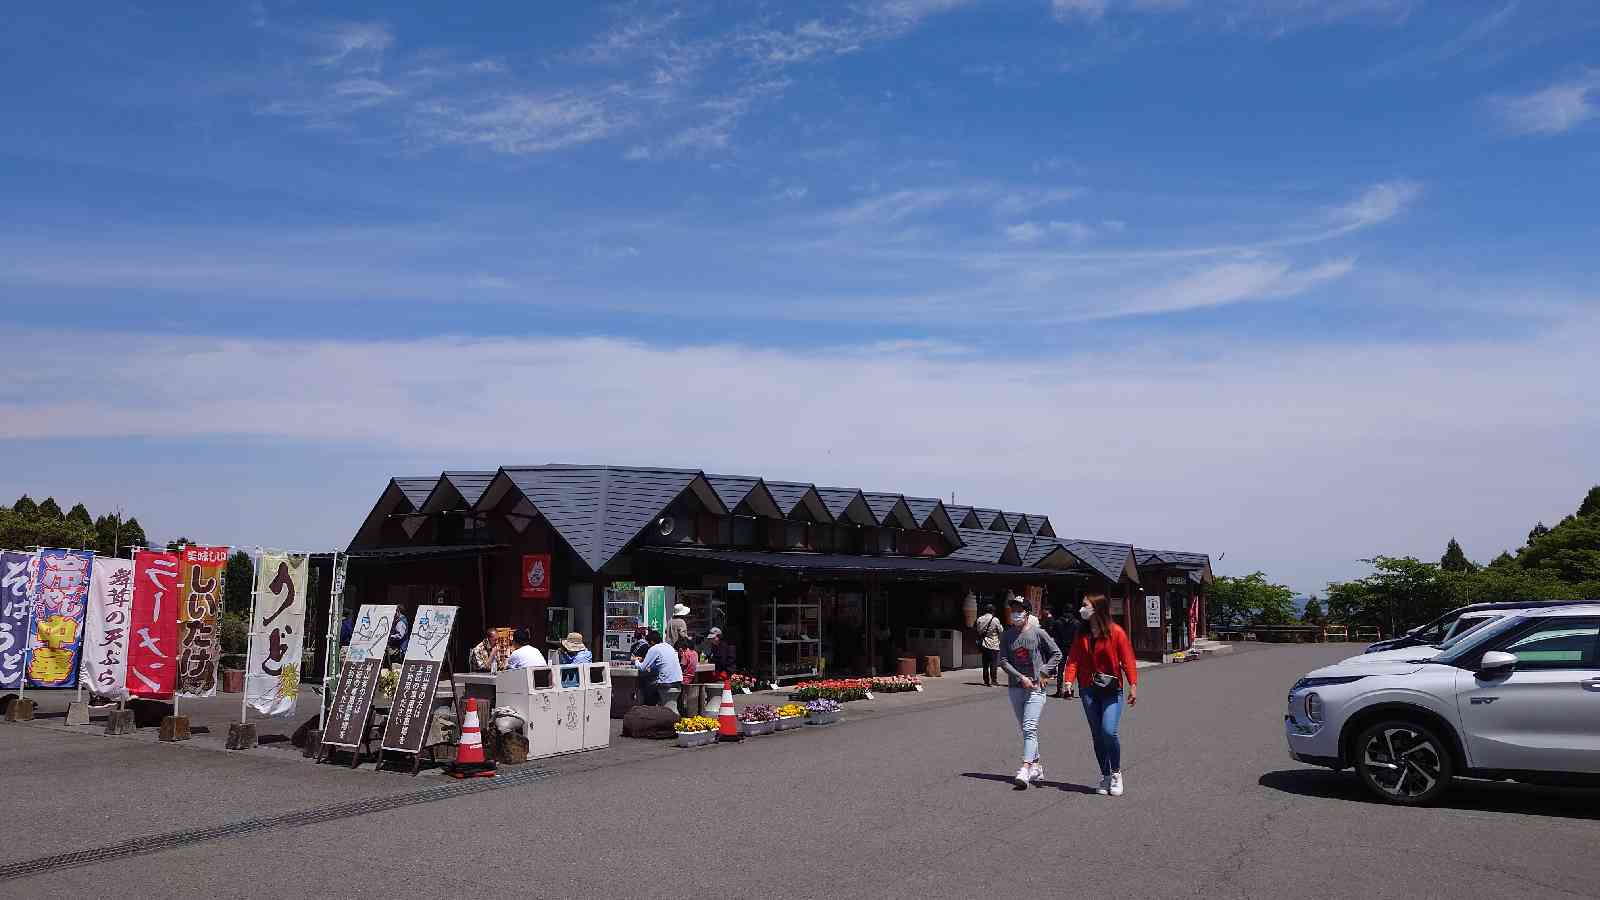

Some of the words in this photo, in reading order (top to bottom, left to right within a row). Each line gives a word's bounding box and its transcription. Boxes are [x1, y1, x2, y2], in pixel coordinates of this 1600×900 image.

[132, 559, 177, 693] ラーメン
[181, 564, 217, 677] しいたけ
